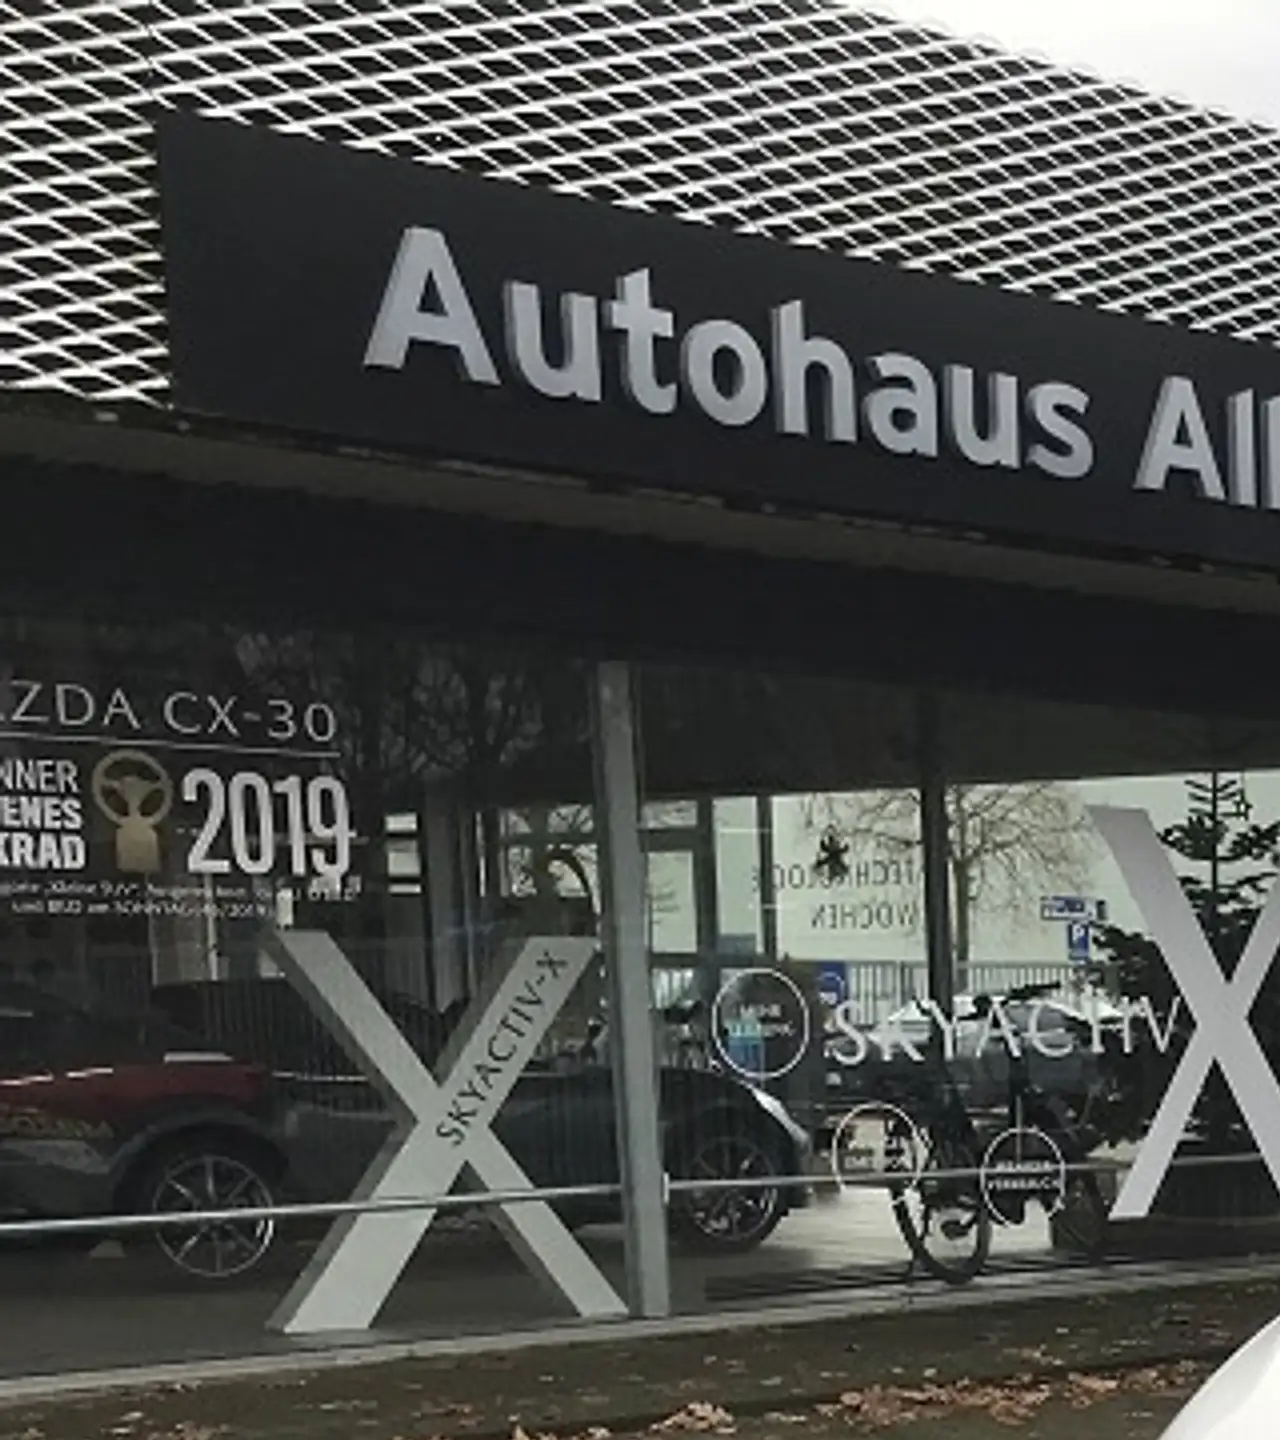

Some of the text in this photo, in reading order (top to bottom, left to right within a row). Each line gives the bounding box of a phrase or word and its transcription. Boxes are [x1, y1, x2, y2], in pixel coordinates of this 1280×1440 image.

[364, 226, 1094, 478] Autohaus
[0, 679, 337, 742] ZDA CX-30
[0, 796, 83, 830] ENES
[182, 768, 350, 876] 2019
[436, 951, 568, 1147] SKYACTIV-X
[832, 995, 1182, 1066] SKYACTIV
